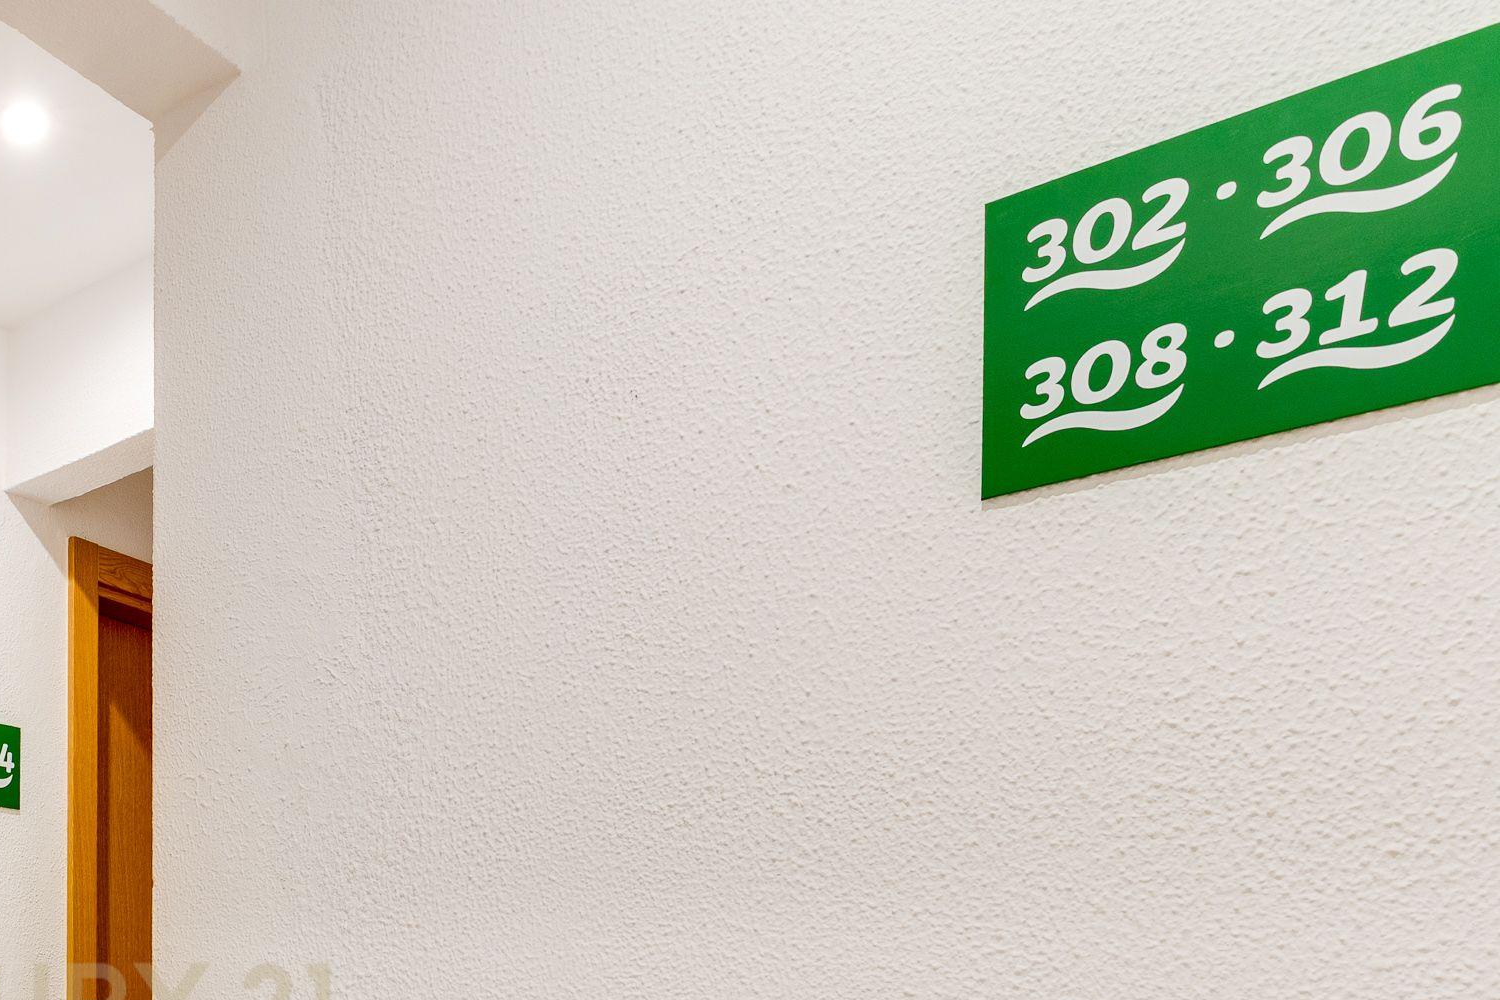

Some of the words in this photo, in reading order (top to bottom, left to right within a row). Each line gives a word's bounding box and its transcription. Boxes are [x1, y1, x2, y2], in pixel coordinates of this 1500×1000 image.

[1021, 177, 1190, 283] 302
[1256, 83, 1463, 208] 306
[1019, 322, 1189, 420] 308
[1255, 247, 1460, 359] 312
